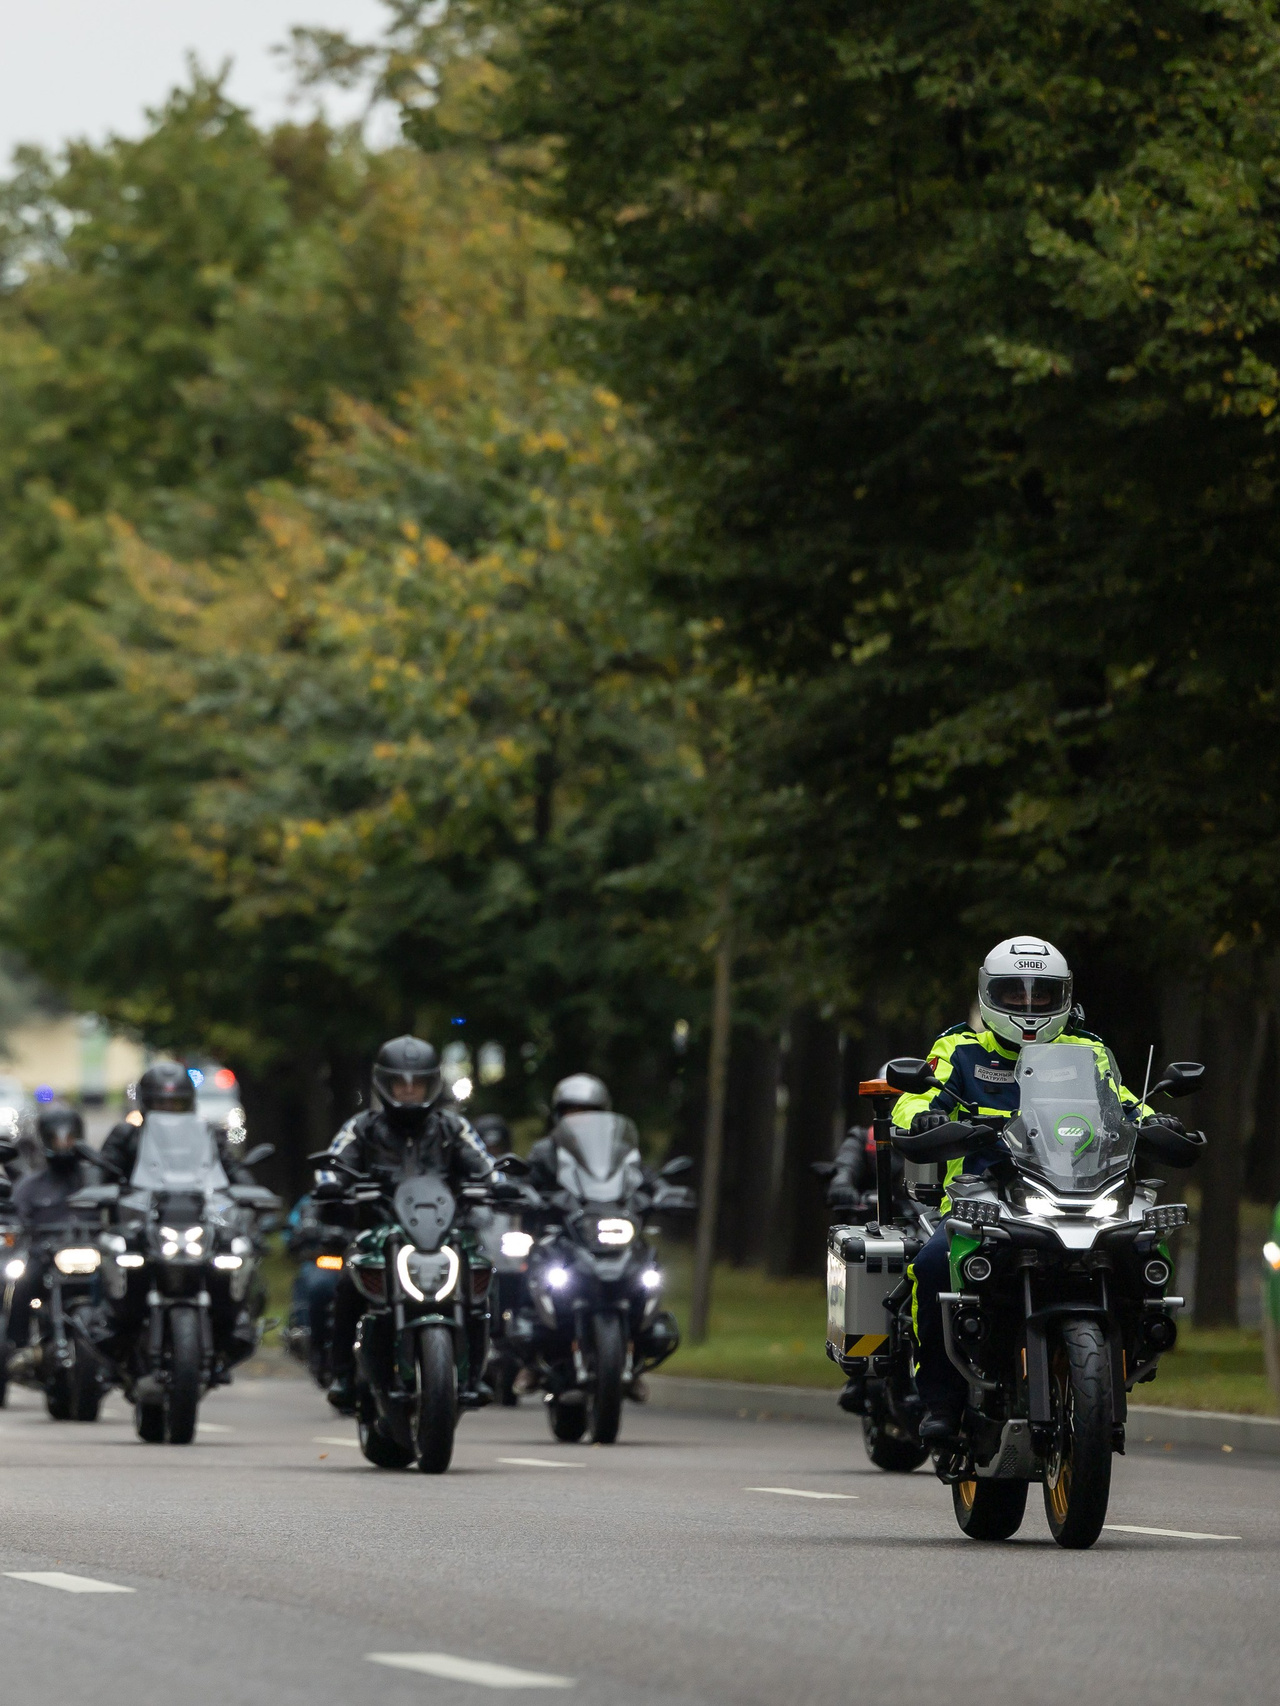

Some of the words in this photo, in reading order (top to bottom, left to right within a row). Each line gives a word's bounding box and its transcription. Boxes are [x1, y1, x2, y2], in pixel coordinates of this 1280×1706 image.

[1018, 960, 1043, 969] SHOEI
[977, 1068, 1013, 1077] ДОРОЖНЫЙ
[981, 1074, 1008, 1082] ПАТРУЛЬ
